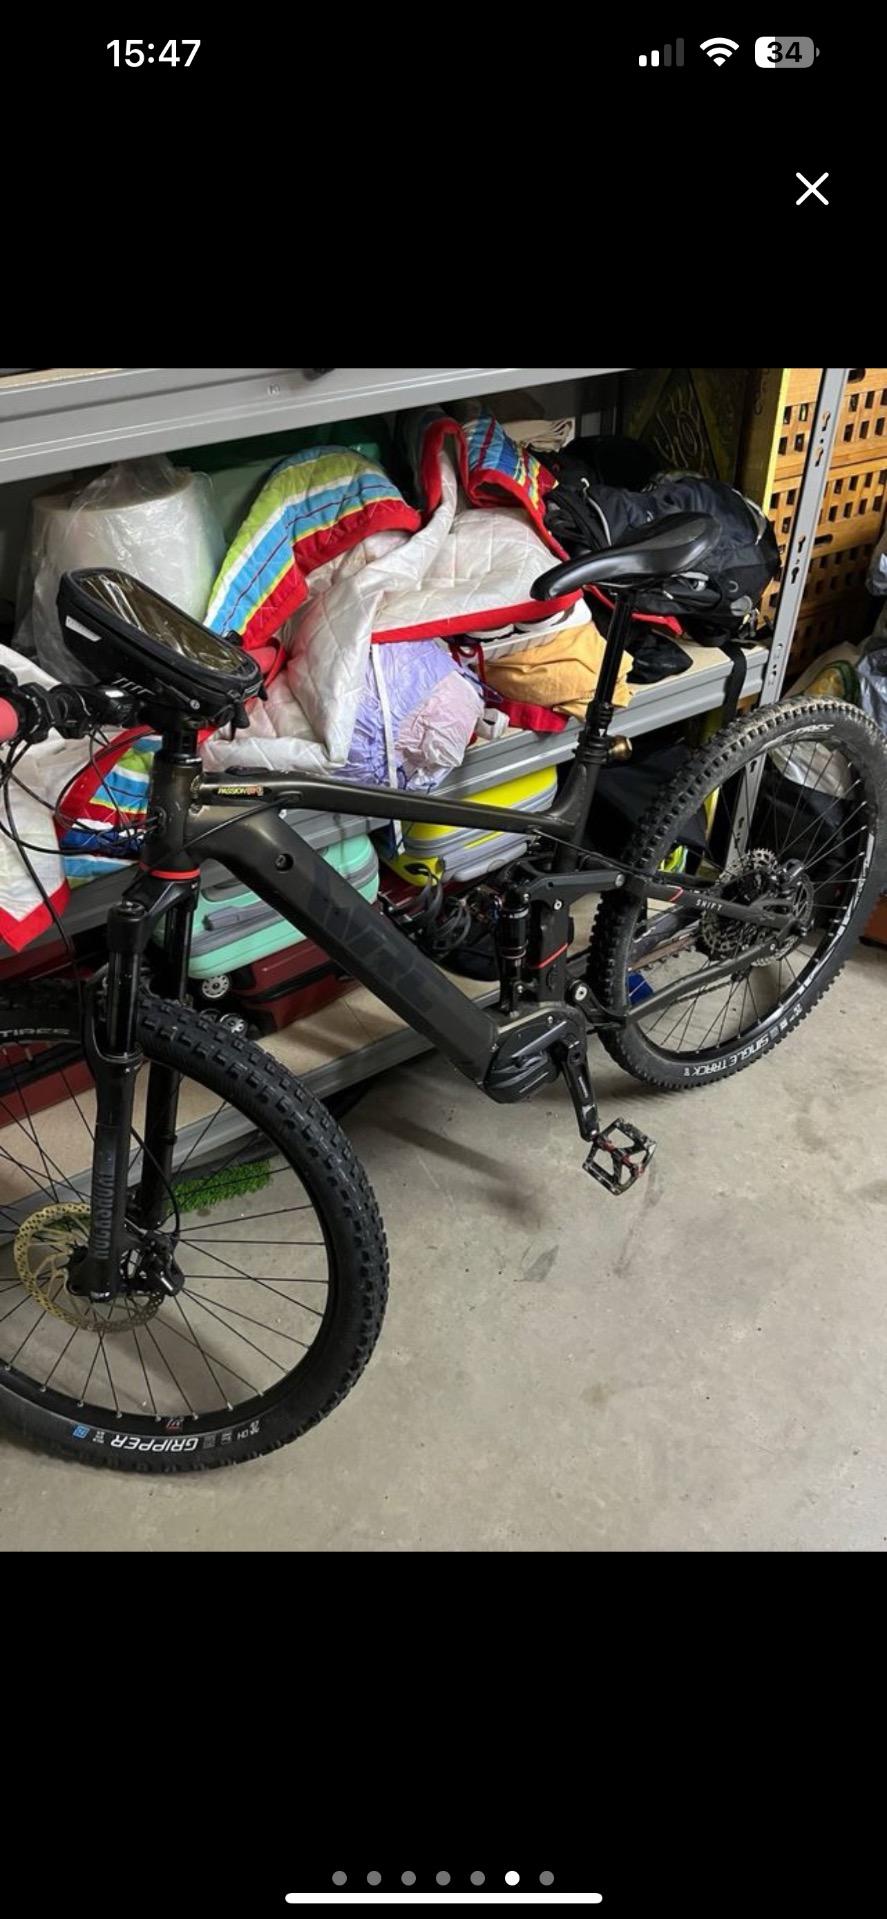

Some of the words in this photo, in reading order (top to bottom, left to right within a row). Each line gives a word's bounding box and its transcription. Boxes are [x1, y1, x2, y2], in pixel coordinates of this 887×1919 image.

[695, 898, 723, 912] SHIFT
[729, 1034, 769, 1066] SINGLE
[692, 1059, 727, 1076] TRACK
[110, 1435, 199, 1453] GRIPPER
